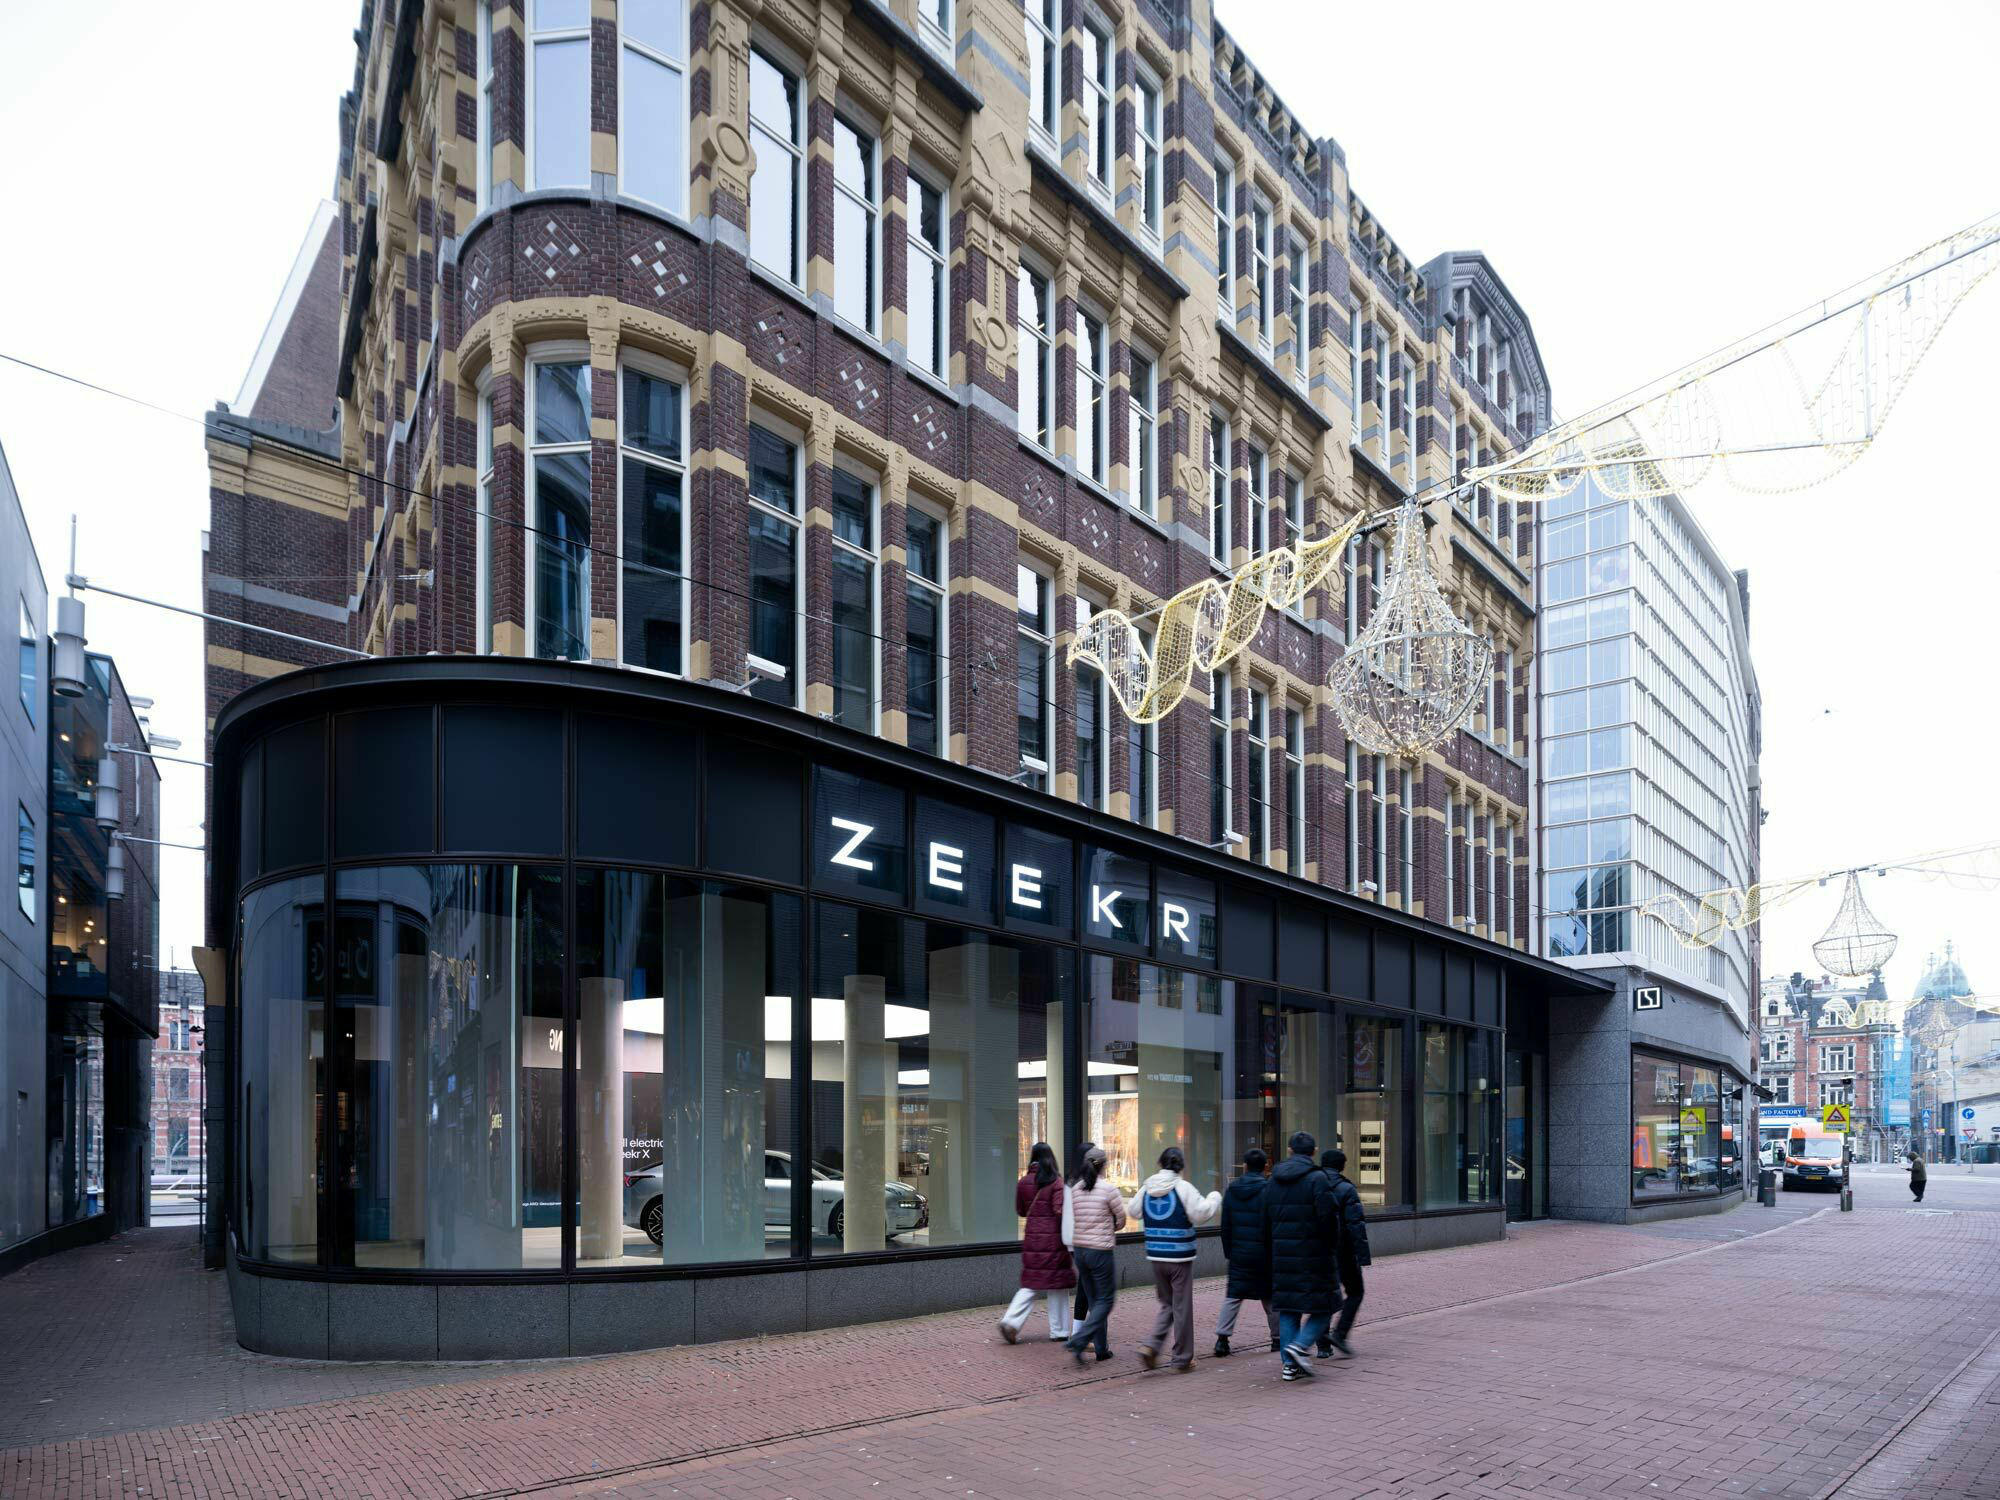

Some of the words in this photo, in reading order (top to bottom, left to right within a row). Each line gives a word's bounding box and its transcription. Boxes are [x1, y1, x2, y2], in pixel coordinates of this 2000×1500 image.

[830, 816, 1191, 943] ZEEKR
[630, 1138, 664, 1148] electric
[642, 1149, 650, 1159] X
